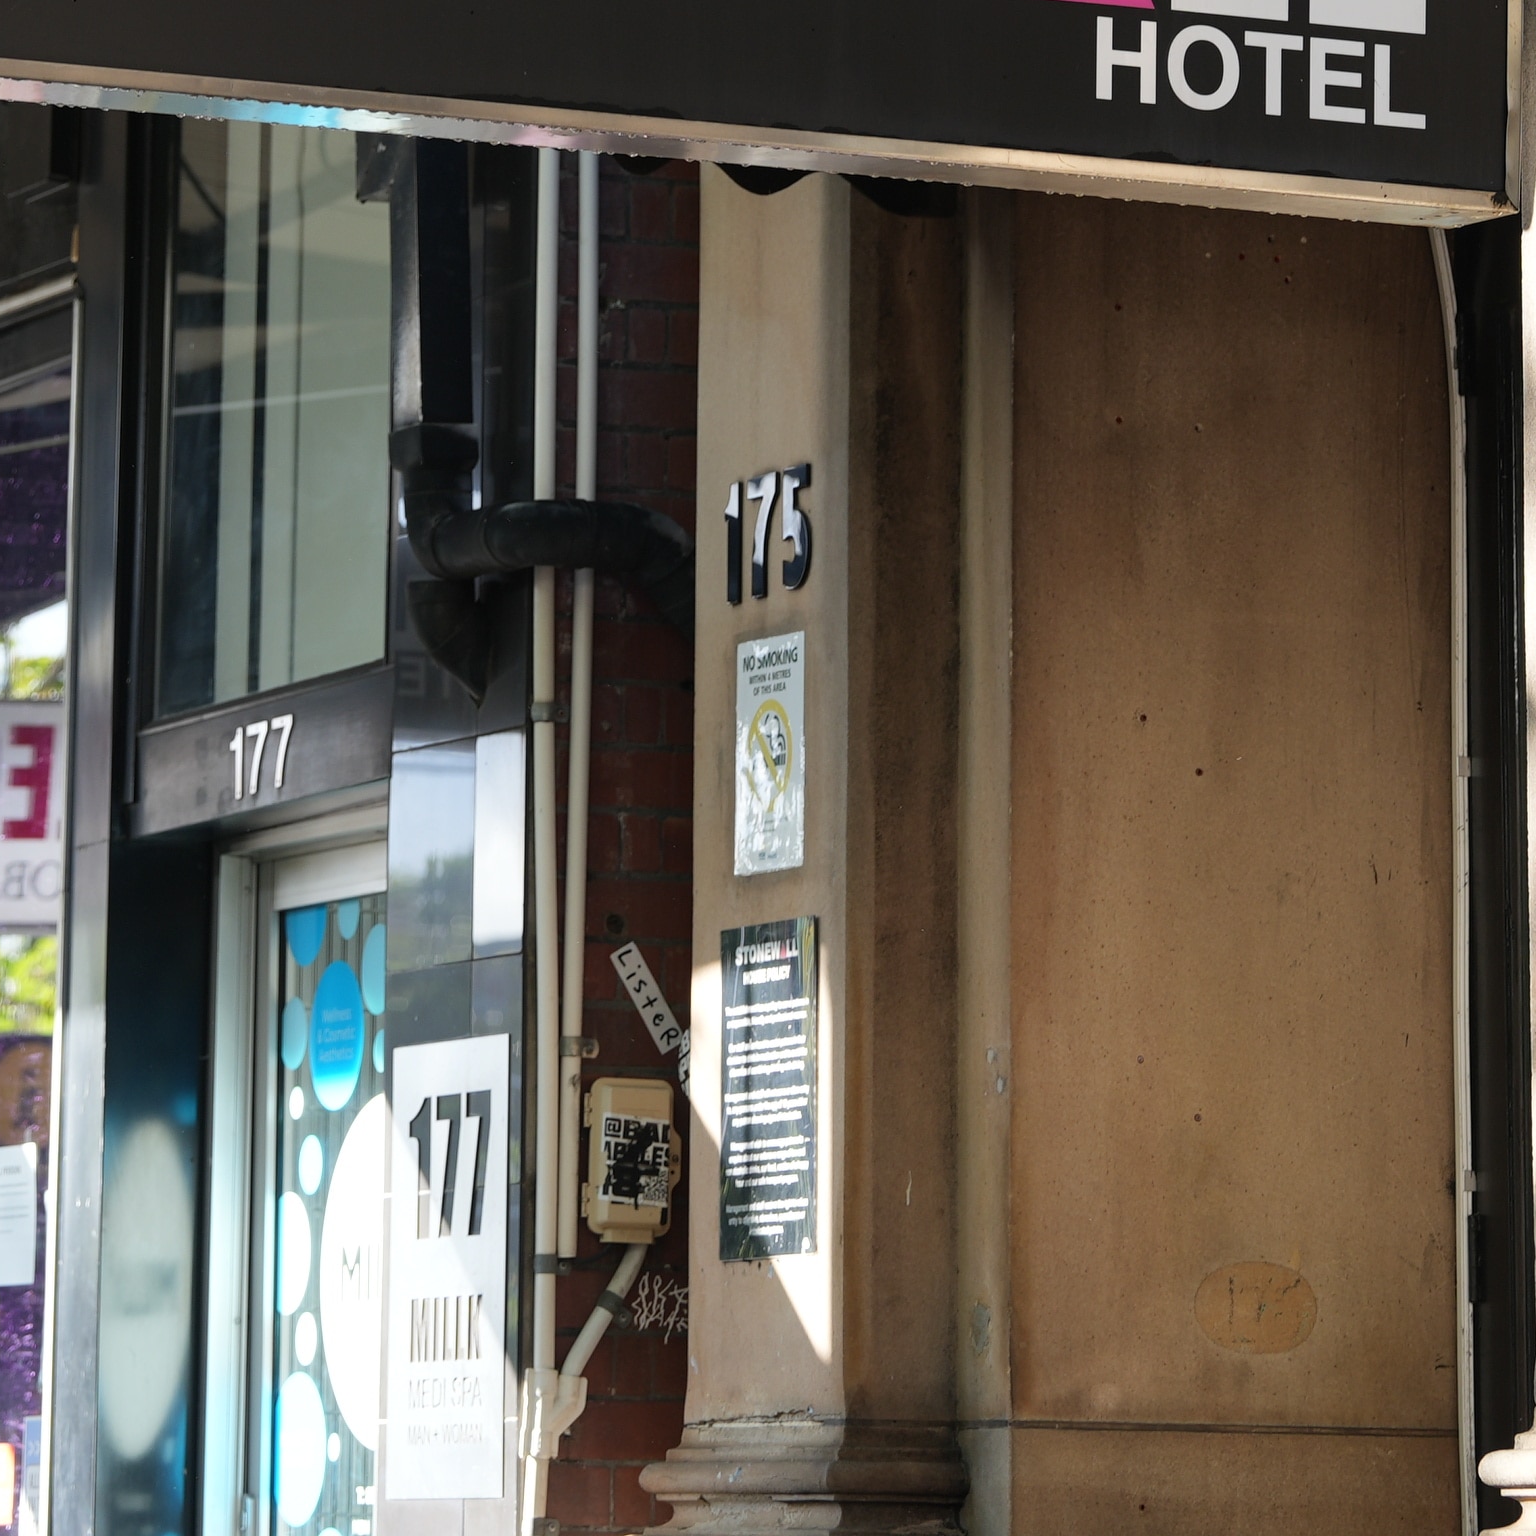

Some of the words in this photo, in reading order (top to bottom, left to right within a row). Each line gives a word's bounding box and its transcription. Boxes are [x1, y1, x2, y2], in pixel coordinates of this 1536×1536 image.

[1095, 17, 1427, 130] HOTEL
[724, 463, 812, 605] 175
[742, 654, 756, 673] NO
[757, 646, 799, 670] SMOKING
[230, 714, 294, 800] 177
[734, 937, 799, 967] STONEWALL
[409, 1089, 492, 1240] 177
[410, 1294, 483, 1363] MILLK
[408, 1424, 431, 1445] MAN
